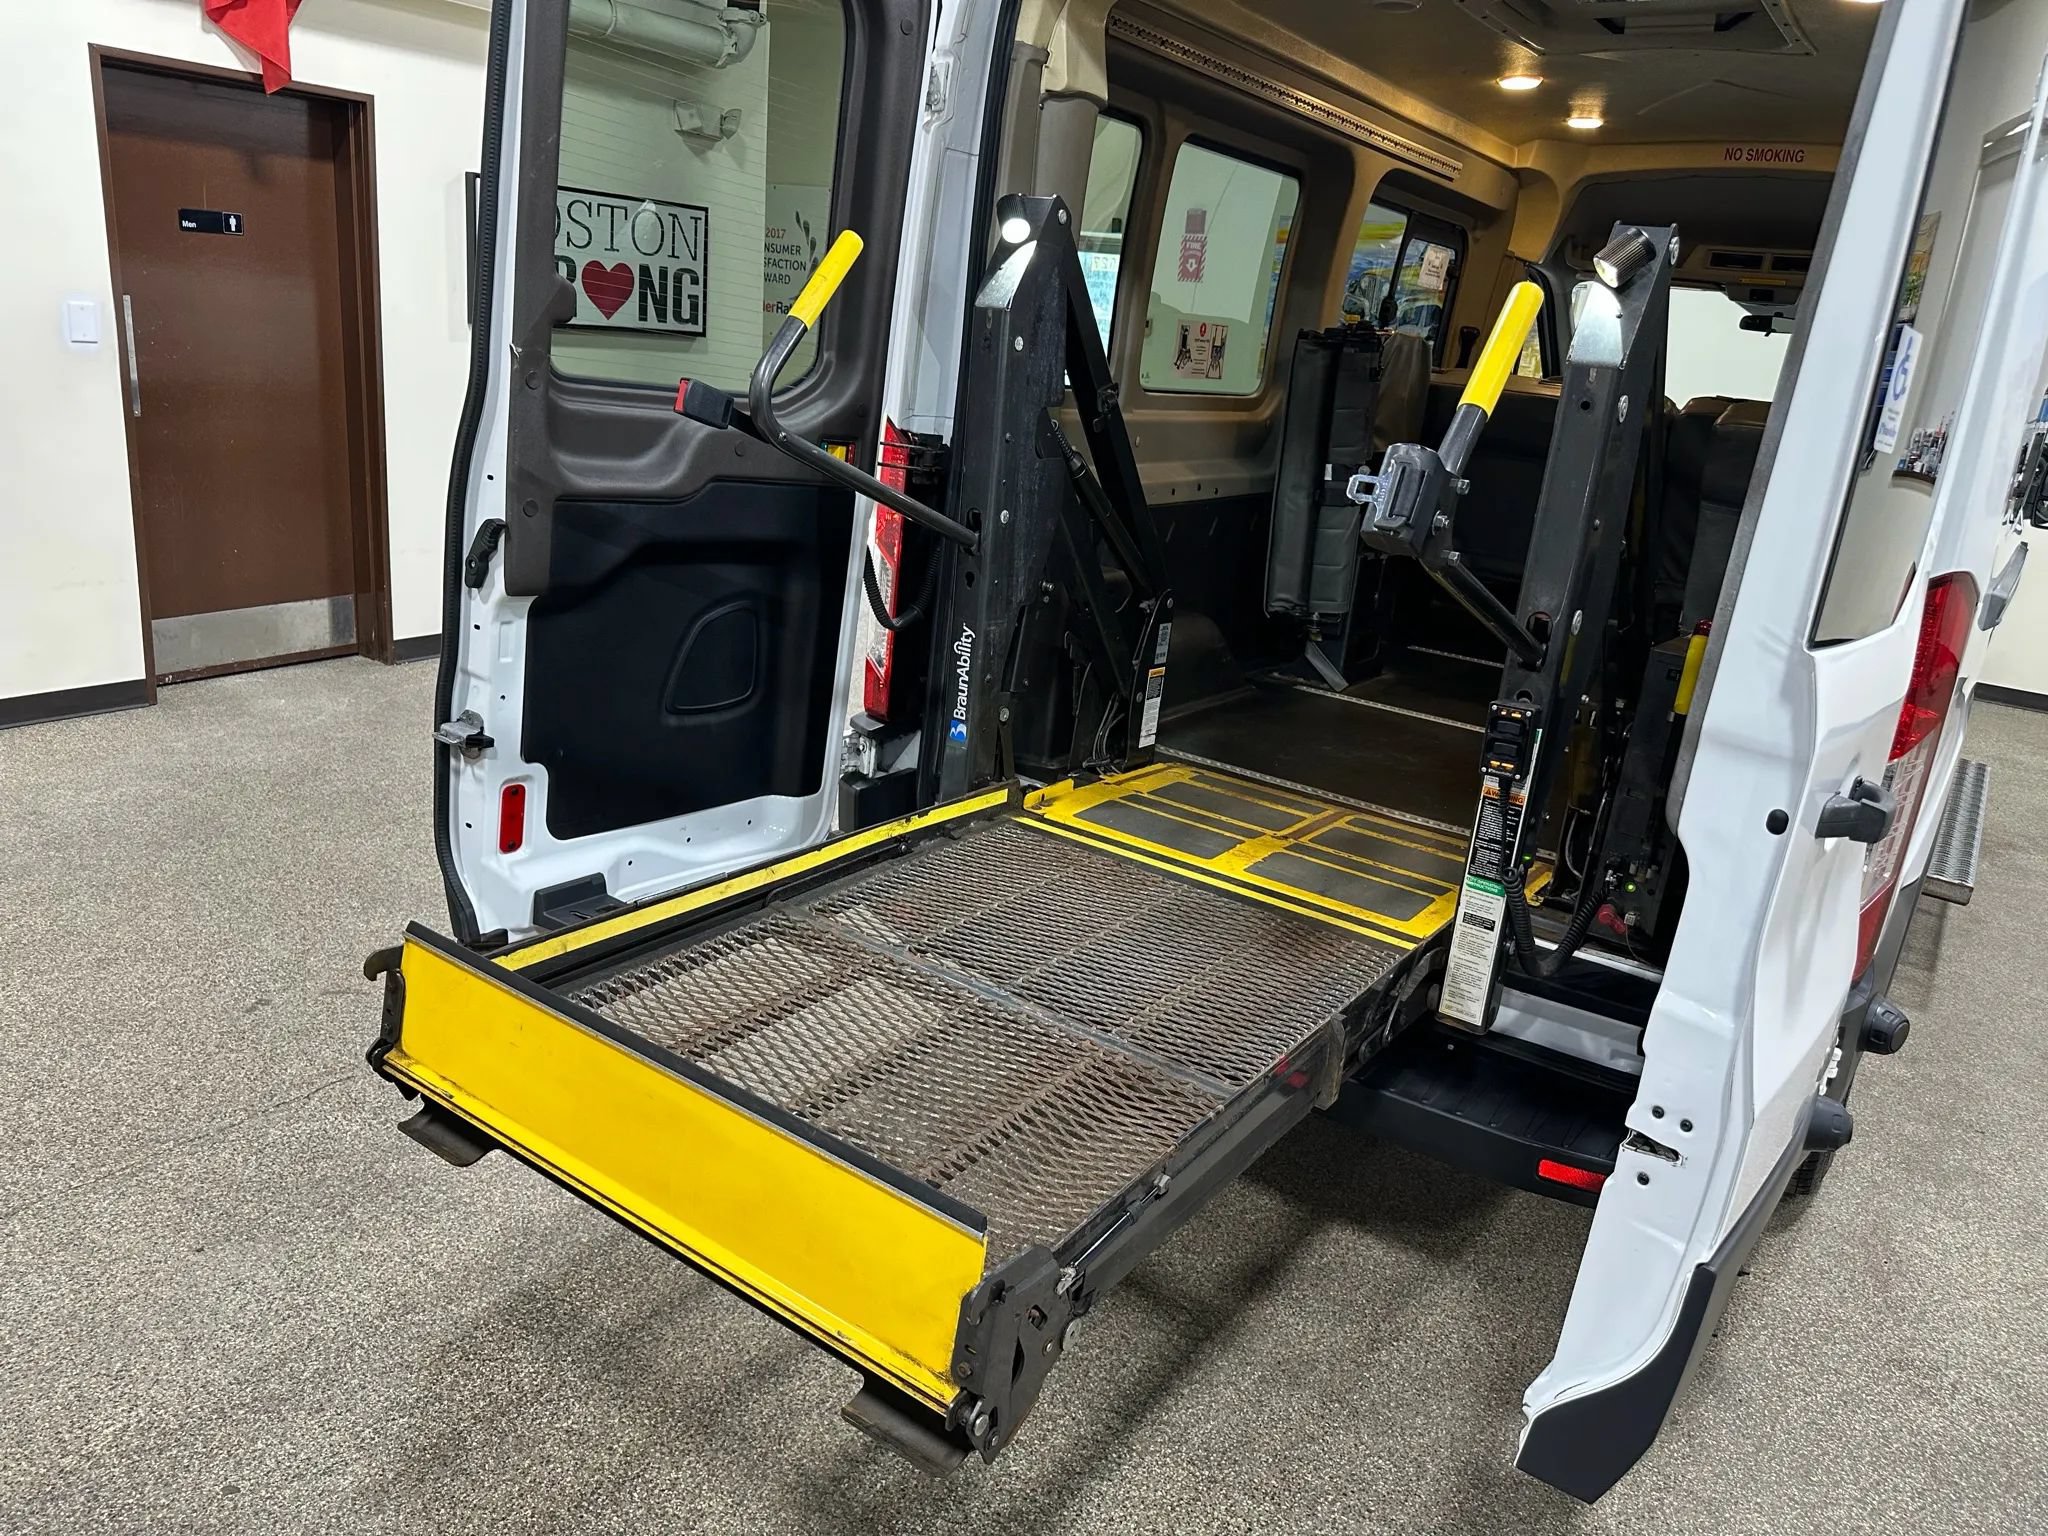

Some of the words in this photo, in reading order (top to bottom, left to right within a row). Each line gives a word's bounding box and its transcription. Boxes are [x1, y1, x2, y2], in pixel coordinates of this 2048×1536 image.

[1724, 147, 1743, 161] NO
[1746, 148, 1805, 163] SMOKING
[181, 220, 197, 229] Men
[555, 199, 702, 261] STON
[765, 227, 786, 239] 2017
[764, 242, 802, 256] NSUMER
[764, 274, 791, 285] WARD
[953, 623, 976, 720] BraunAbility
